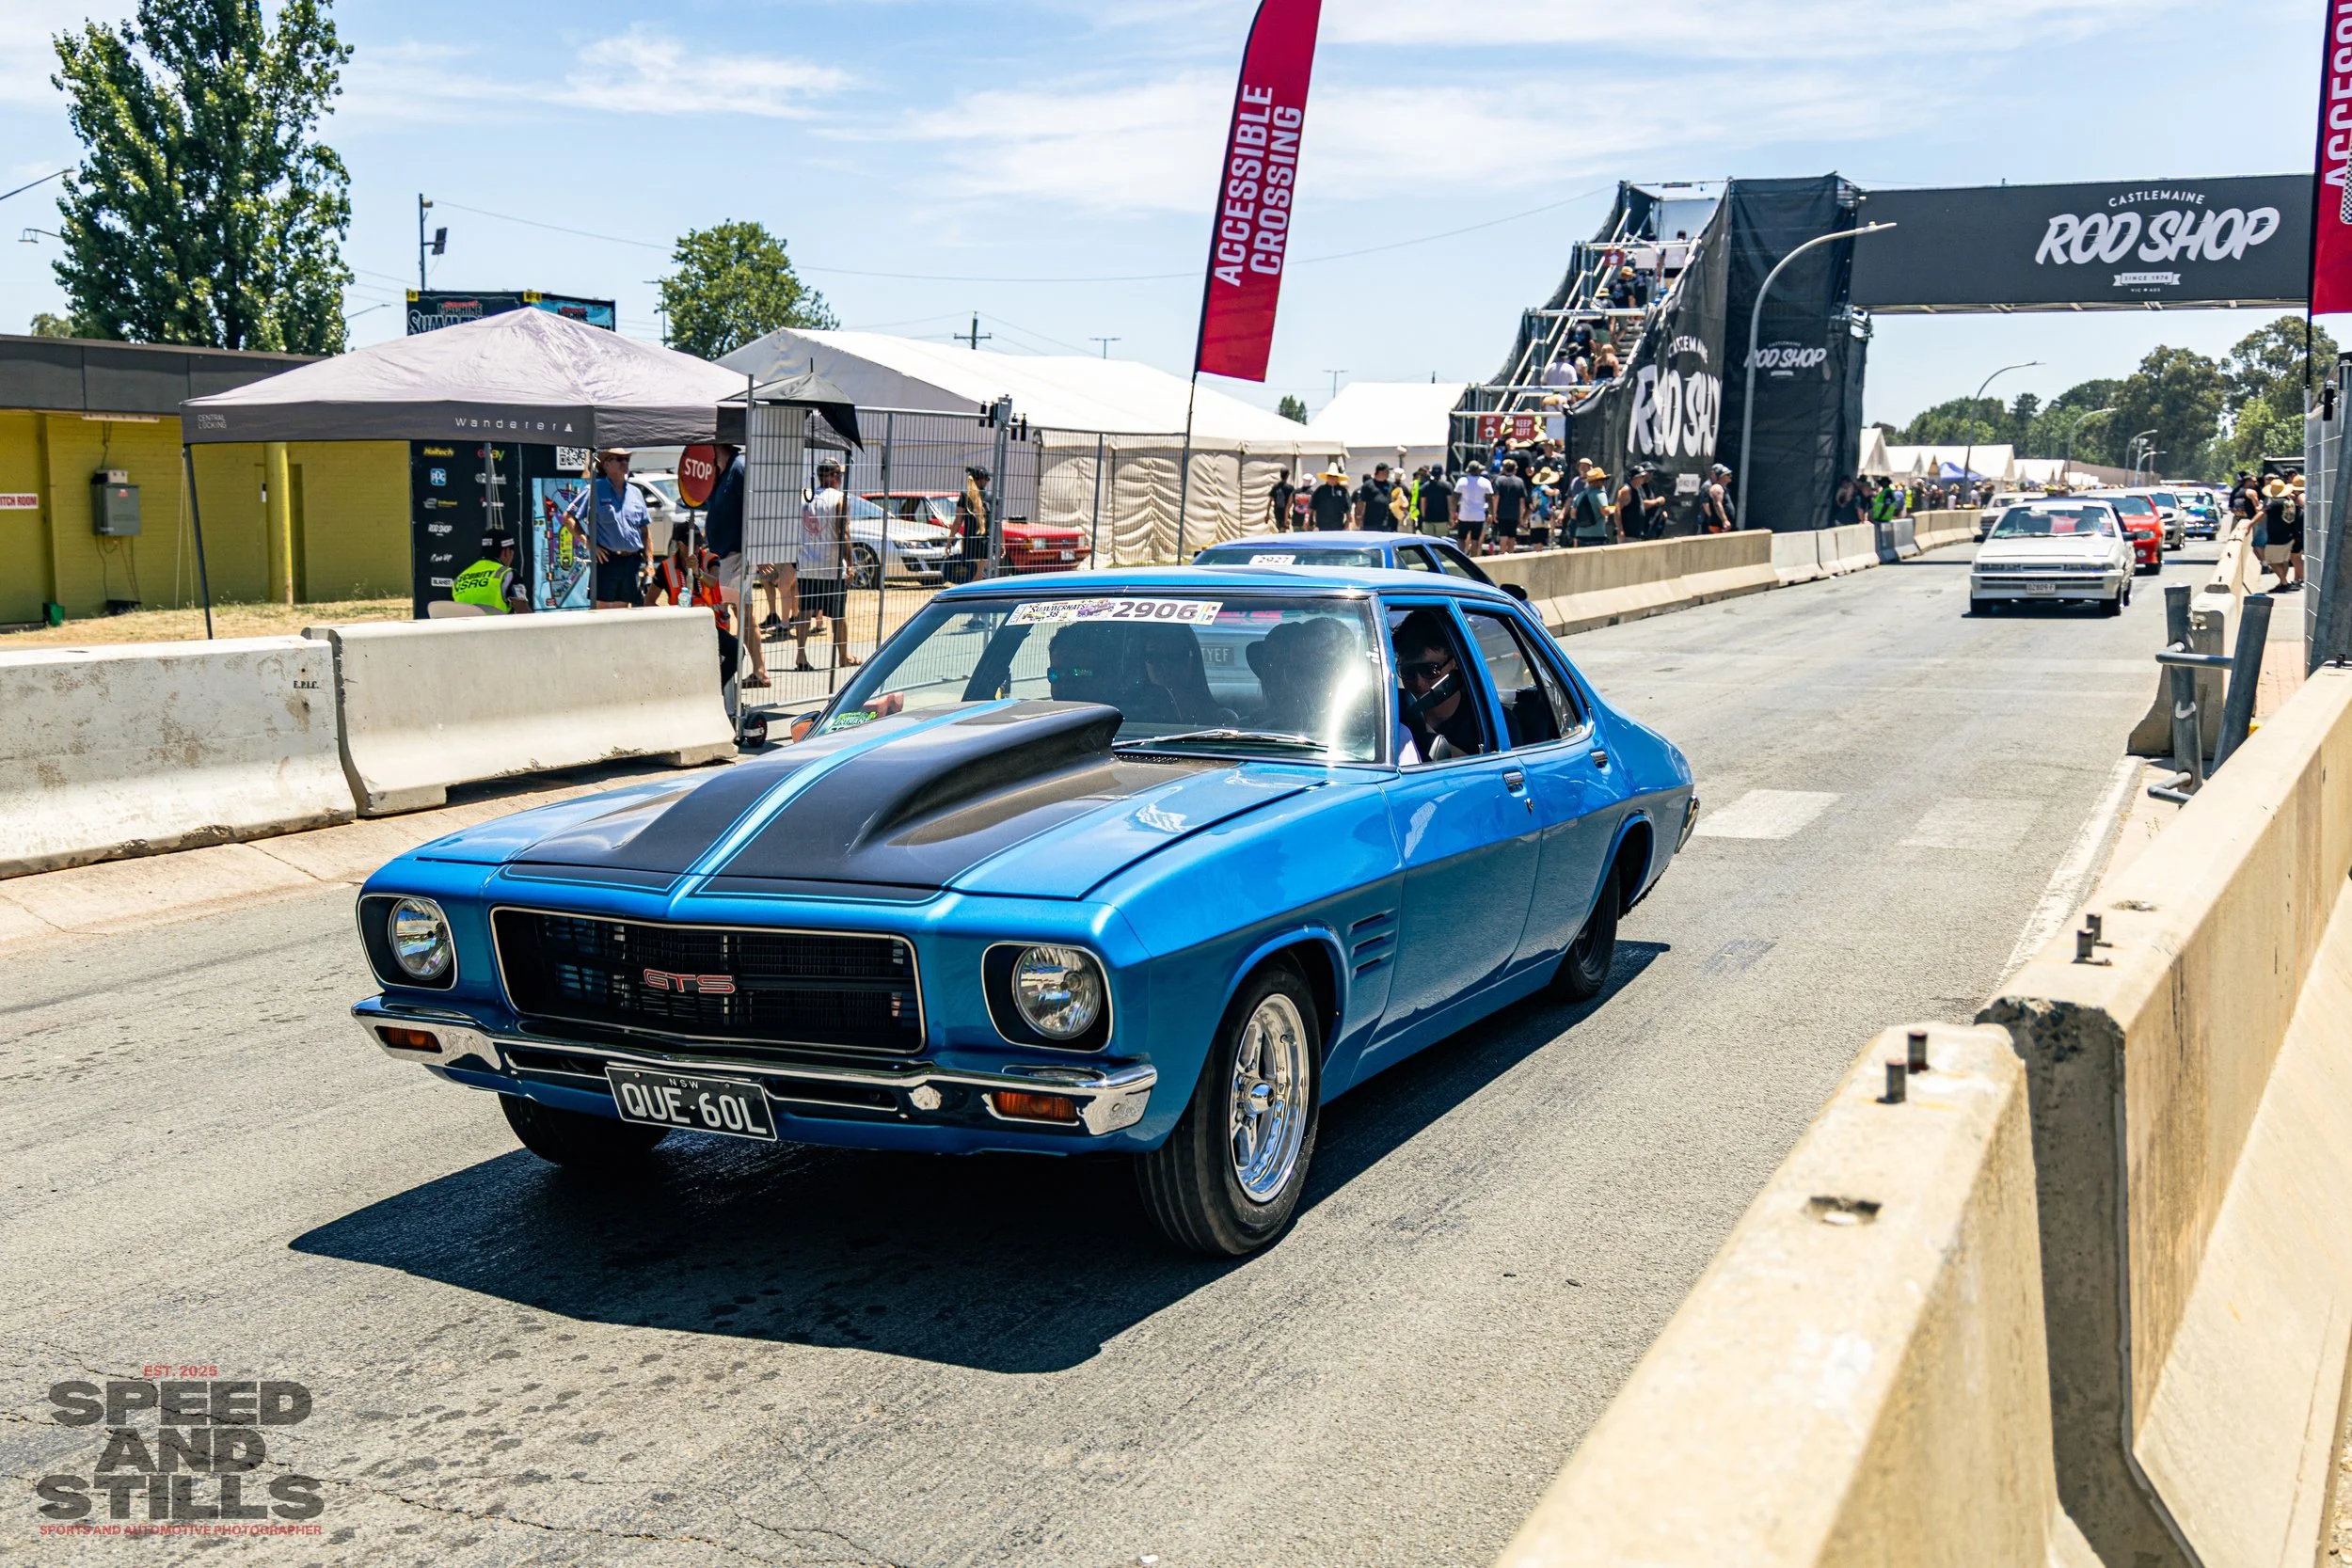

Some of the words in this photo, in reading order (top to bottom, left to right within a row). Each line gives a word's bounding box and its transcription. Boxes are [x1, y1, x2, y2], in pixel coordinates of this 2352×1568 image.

[1215, 85, 1273, 287] ACCESSIBLE
[1249, 105, 1302, 275] CROSSING
[2108, 190, 2205, 207] CASTLEMAINE
[2035, 212, 2142, 265] ROD
[2137, 206, 2280, 263] SHOP
[1778, 347, 1827, 368] SHOP
[198, 414, 226, 422] CENTRAL
[198, 421, 227, 430] LOCKING
[455, 417, 557, 431] Wanderer
[1516, 428, 1531, 436] LEFT
[477, 449, 505, 461] eay
[685, 458, 712, 481] STOP
[17, 496, 37, 506] ROOM
[1113, 601, 1199, 620] 2906
[644, 968, 735, 994] GTS
[668, 1078, 700, 1089] NSW
